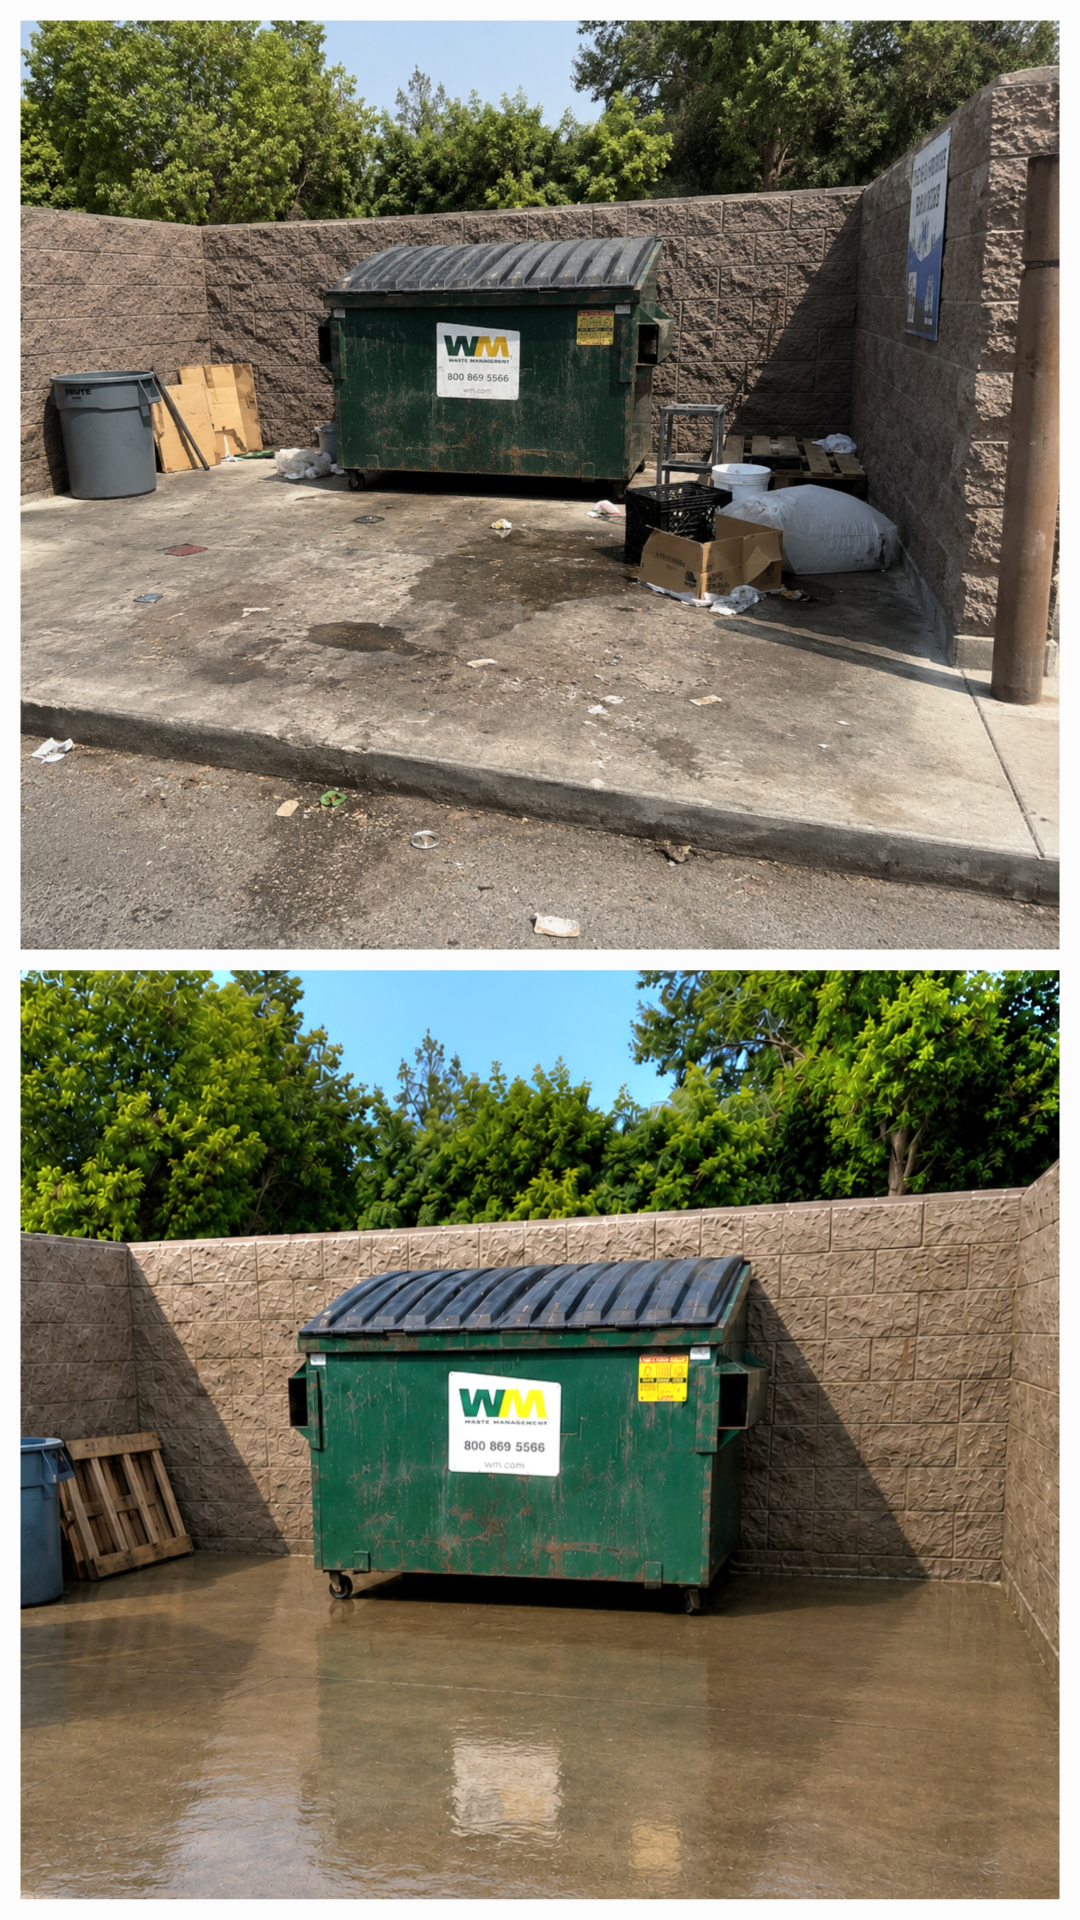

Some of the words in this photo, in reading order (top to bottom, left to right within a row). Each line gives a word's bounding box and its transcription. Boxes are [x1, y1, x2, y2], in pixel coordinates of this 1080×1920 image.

[443, 335, 510, 357] WM
[447, 373, 465, 381] 800
[467, 373, 484, 381] 869
[486, 374, 509, 382] 5566
[458, 1388, 548, 1419] WM
[464, 1440, 486, 1451] 800
[489, 1441, 512, 1452] 869
[515, 1441, 546, 1453] 5566
